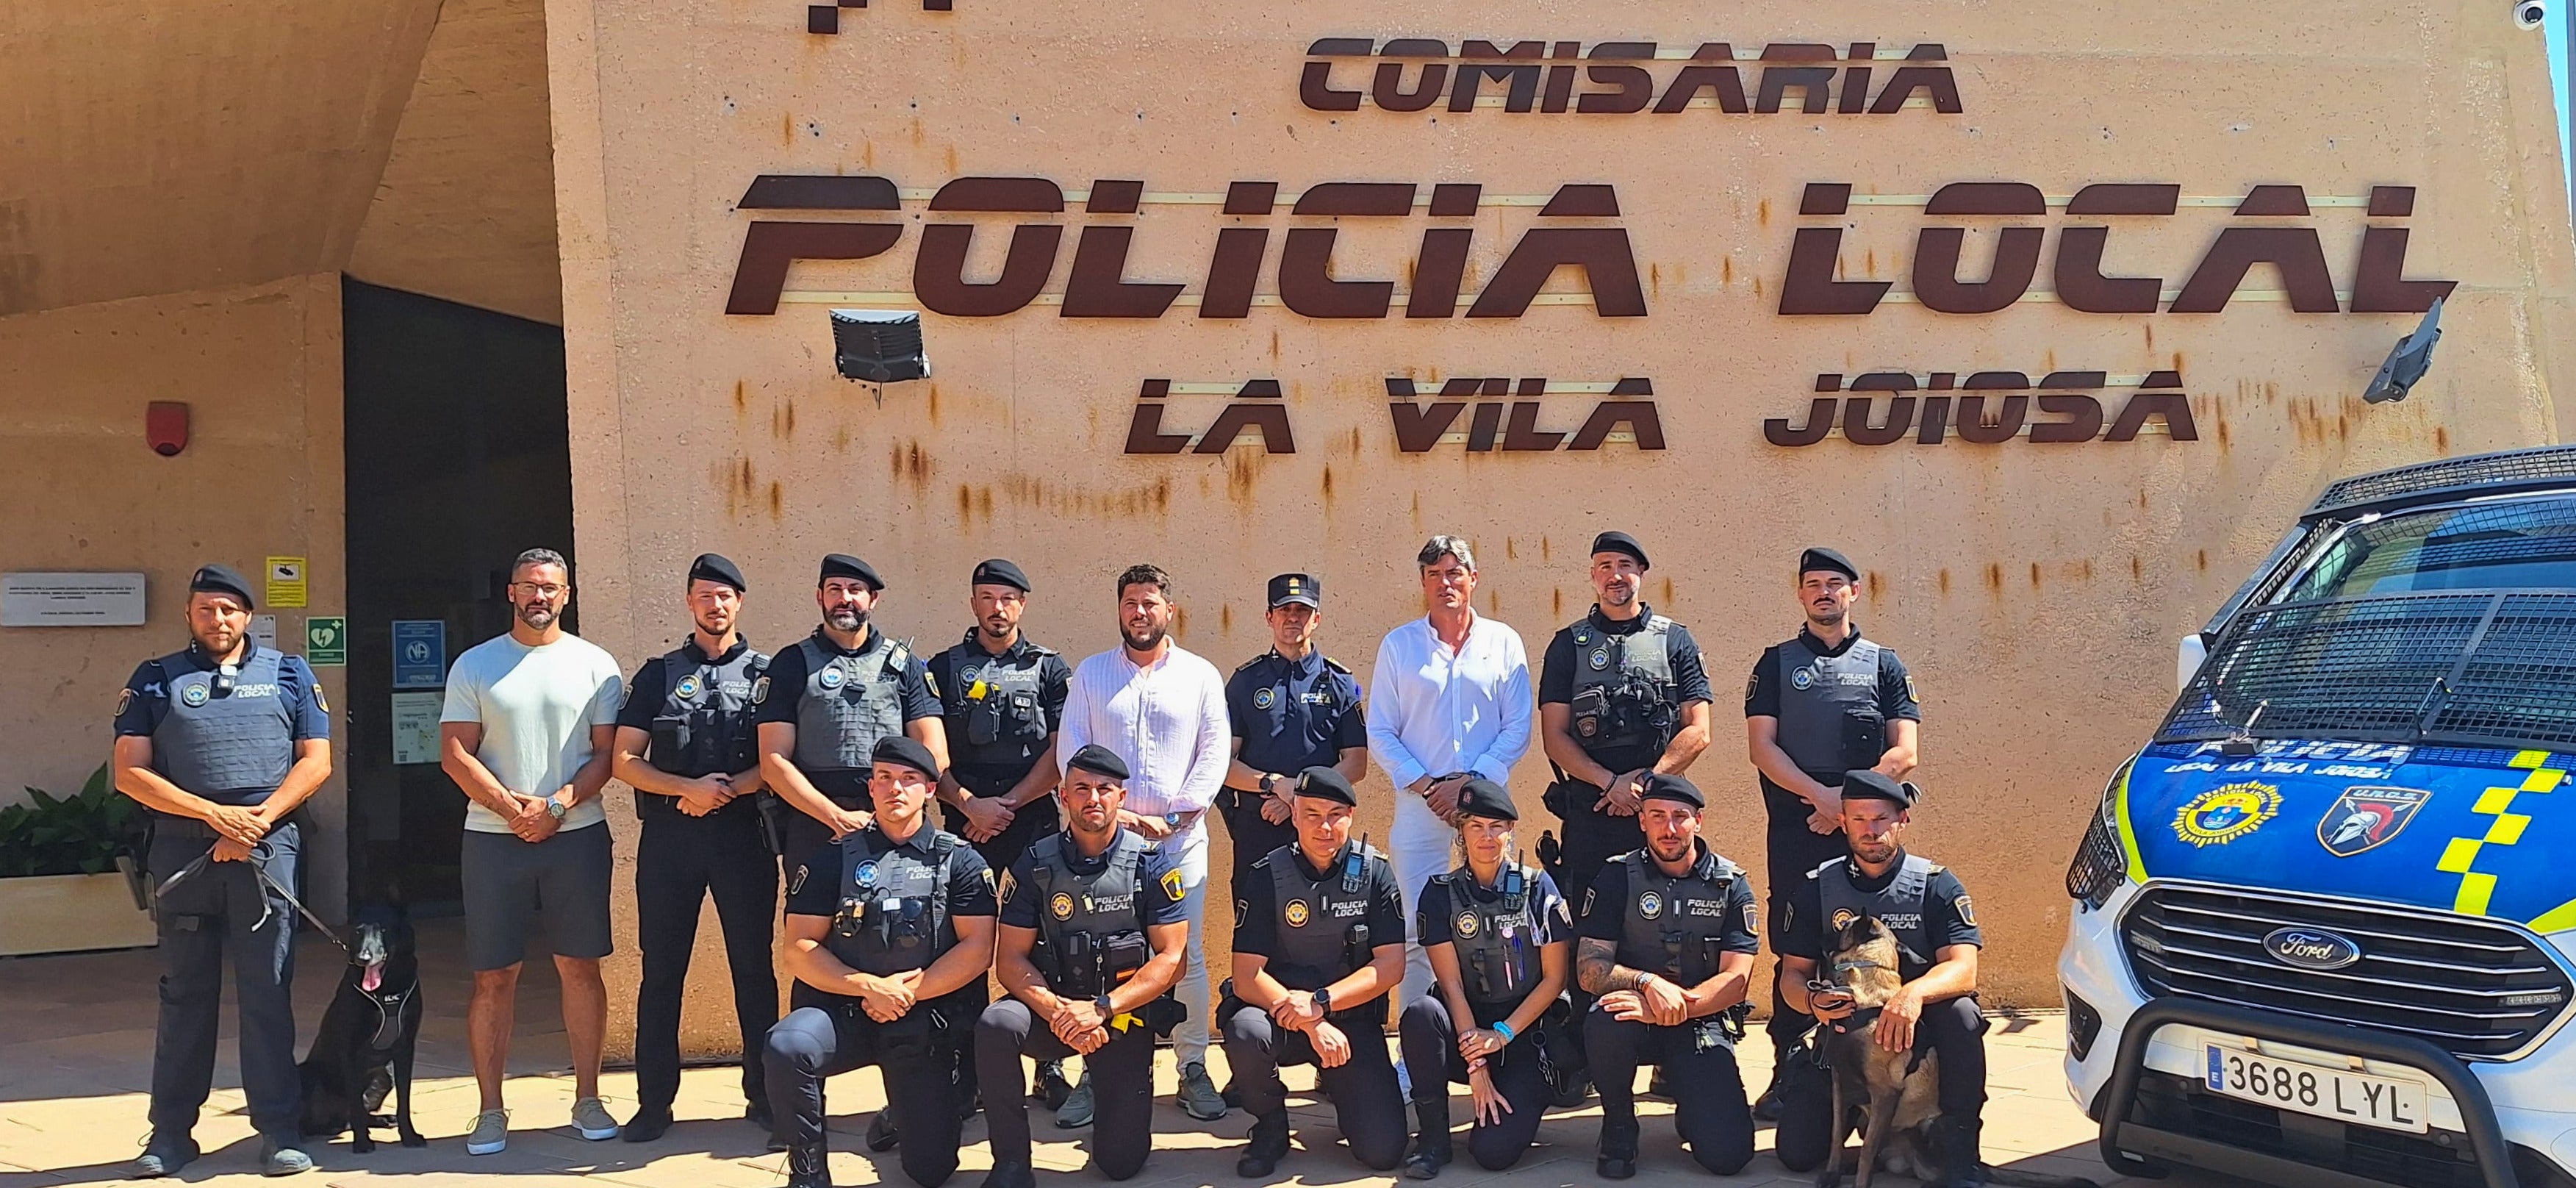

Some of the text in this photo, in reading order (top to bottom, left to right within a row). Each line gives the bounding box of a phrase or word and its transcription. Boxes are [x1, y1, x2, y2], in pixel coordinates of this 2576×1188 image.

[1300, 38, 1962, 114] COMISARIA
[725, 175, 2458, 318] POLICIA LOCAL
[1124, 370, 2199, 454] LA VILA JOIOSA
[234, 684, 276, 692] POLICIA
[238, 689, 270, 698] LOCAL
[2185, 739, 2413, 765] PLICIA
[2225, 762, 2256, 772] LA
[2261, 762, 2309, 773] VILA
[906, 865, 947, 873] POLICA
[1095, 894, 1133, 905] POLICIA
[1687, 899, 1726, 908] POLICIA
[1099, 901, 1130, 912] LOCAL
[1331, 901, 1368, 911] POLICIA
[1335, 908, 1364, 917] LOCAL
[1691, 907, 1721, 917] LOCAL
[1885, 920, 1917, 929] LOCAL
[2281, 933, 2333, 959] Ford
[2211, 1056, 2413, 1124] E 3688 LYL
